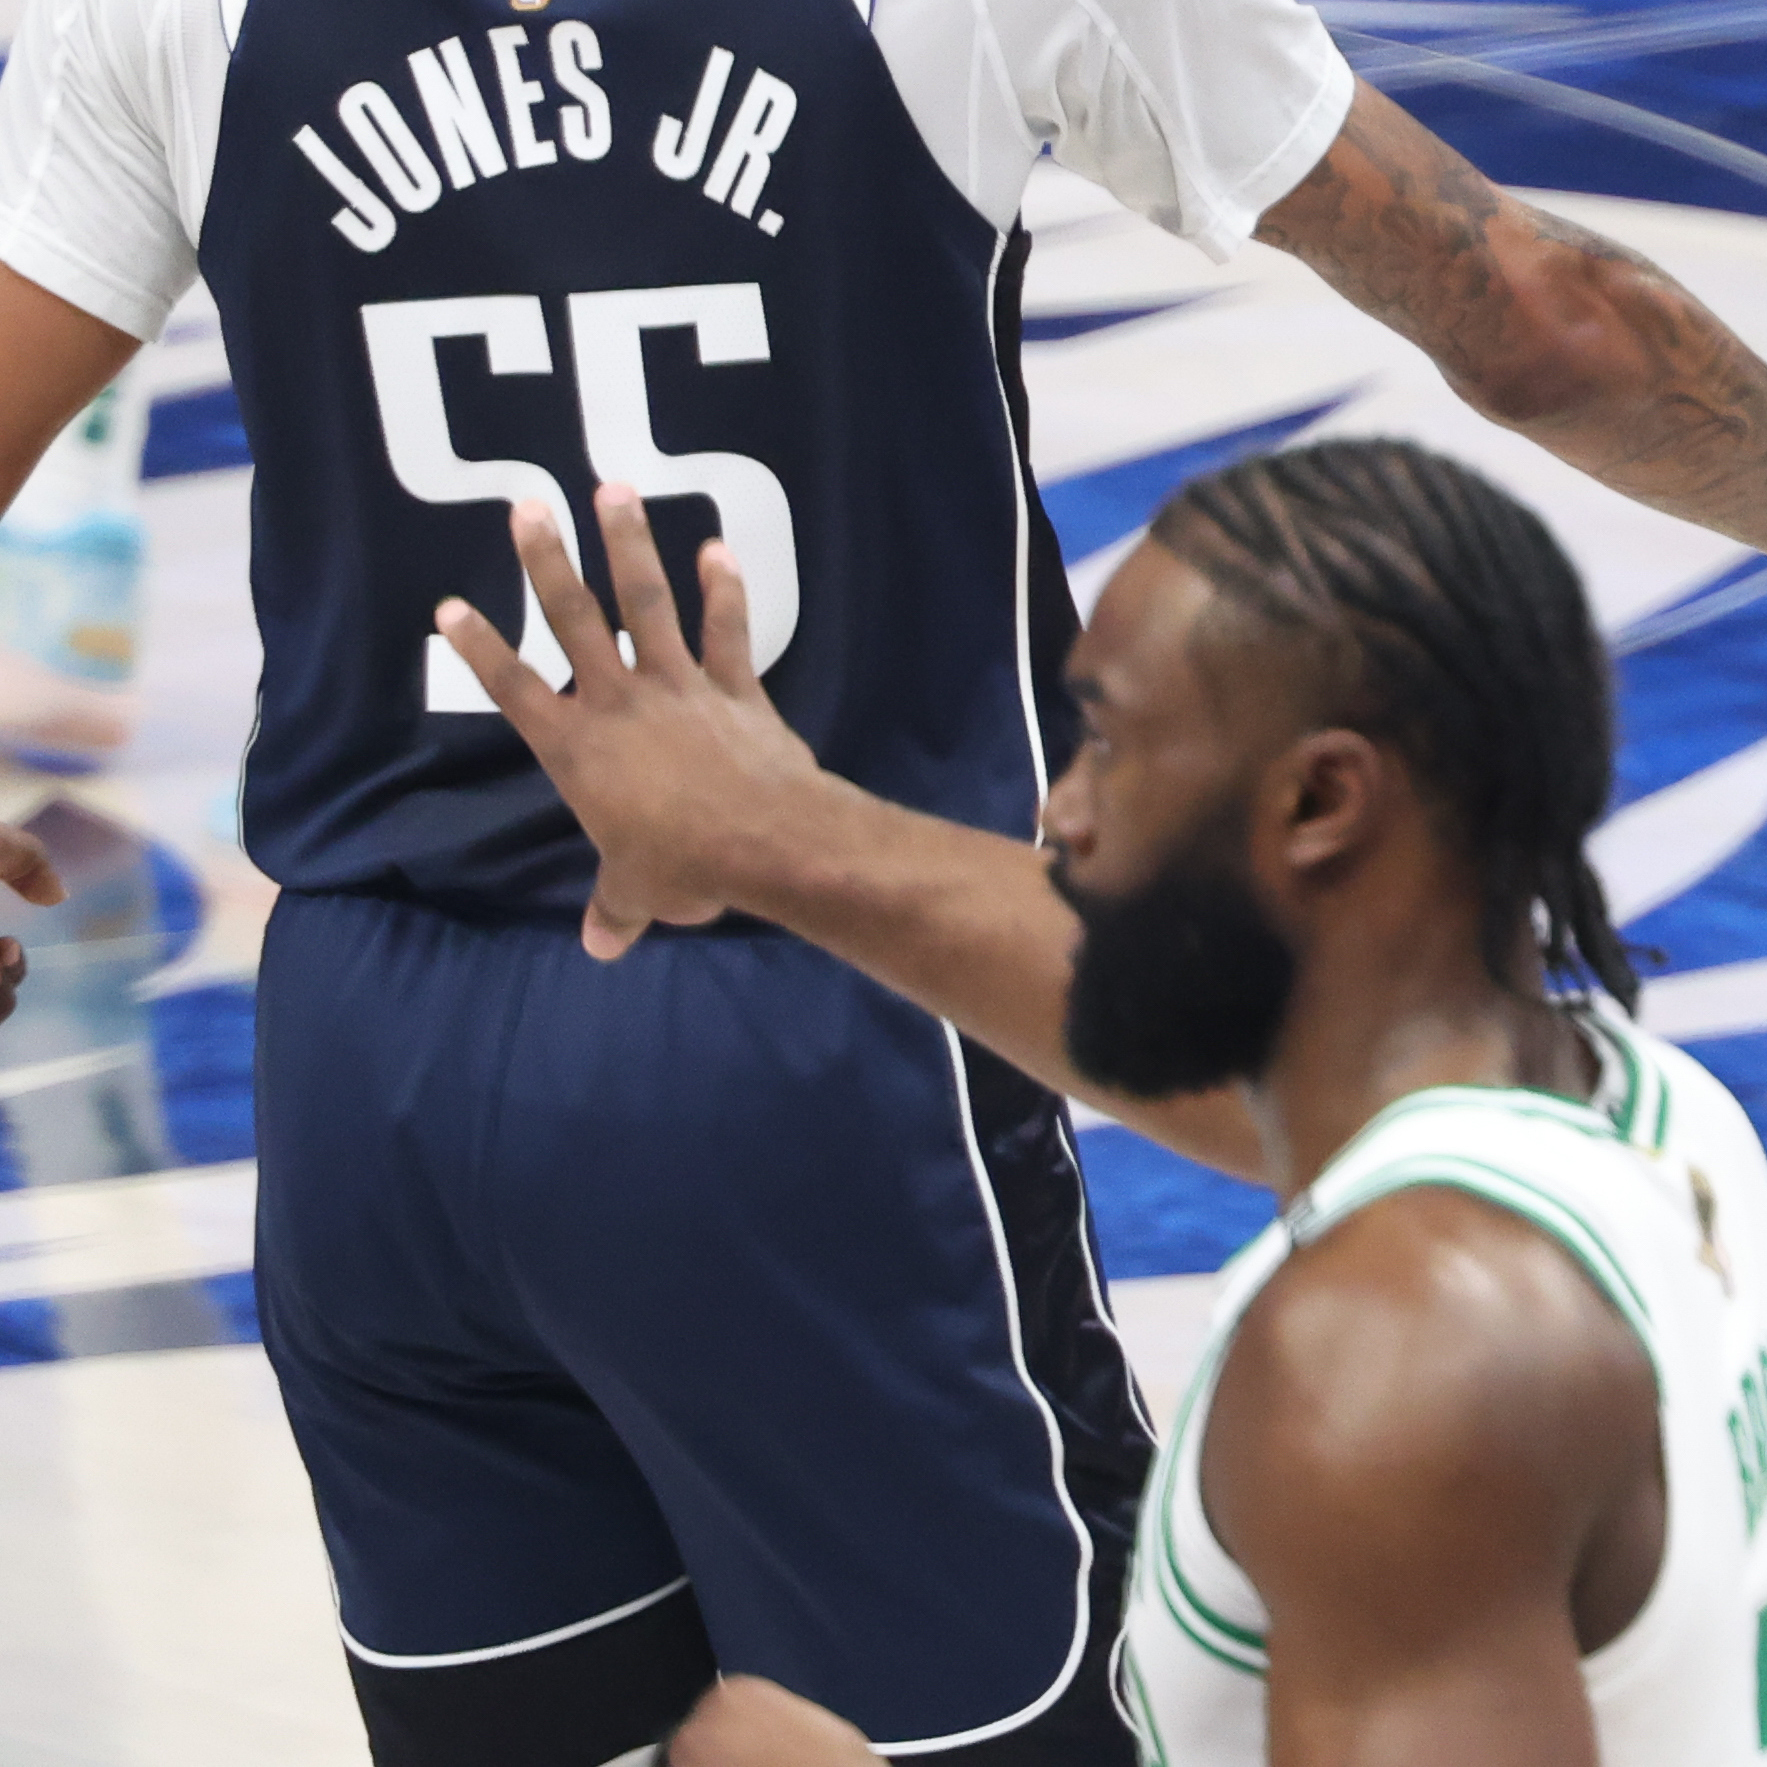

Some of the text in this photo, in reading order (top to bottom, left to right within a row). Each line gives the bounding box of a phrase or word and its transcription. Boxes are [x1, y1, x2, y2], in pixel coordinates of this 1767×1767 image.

[292, 20, 798, 255] JONES JR.
[359, 282, 800, 714] 55
